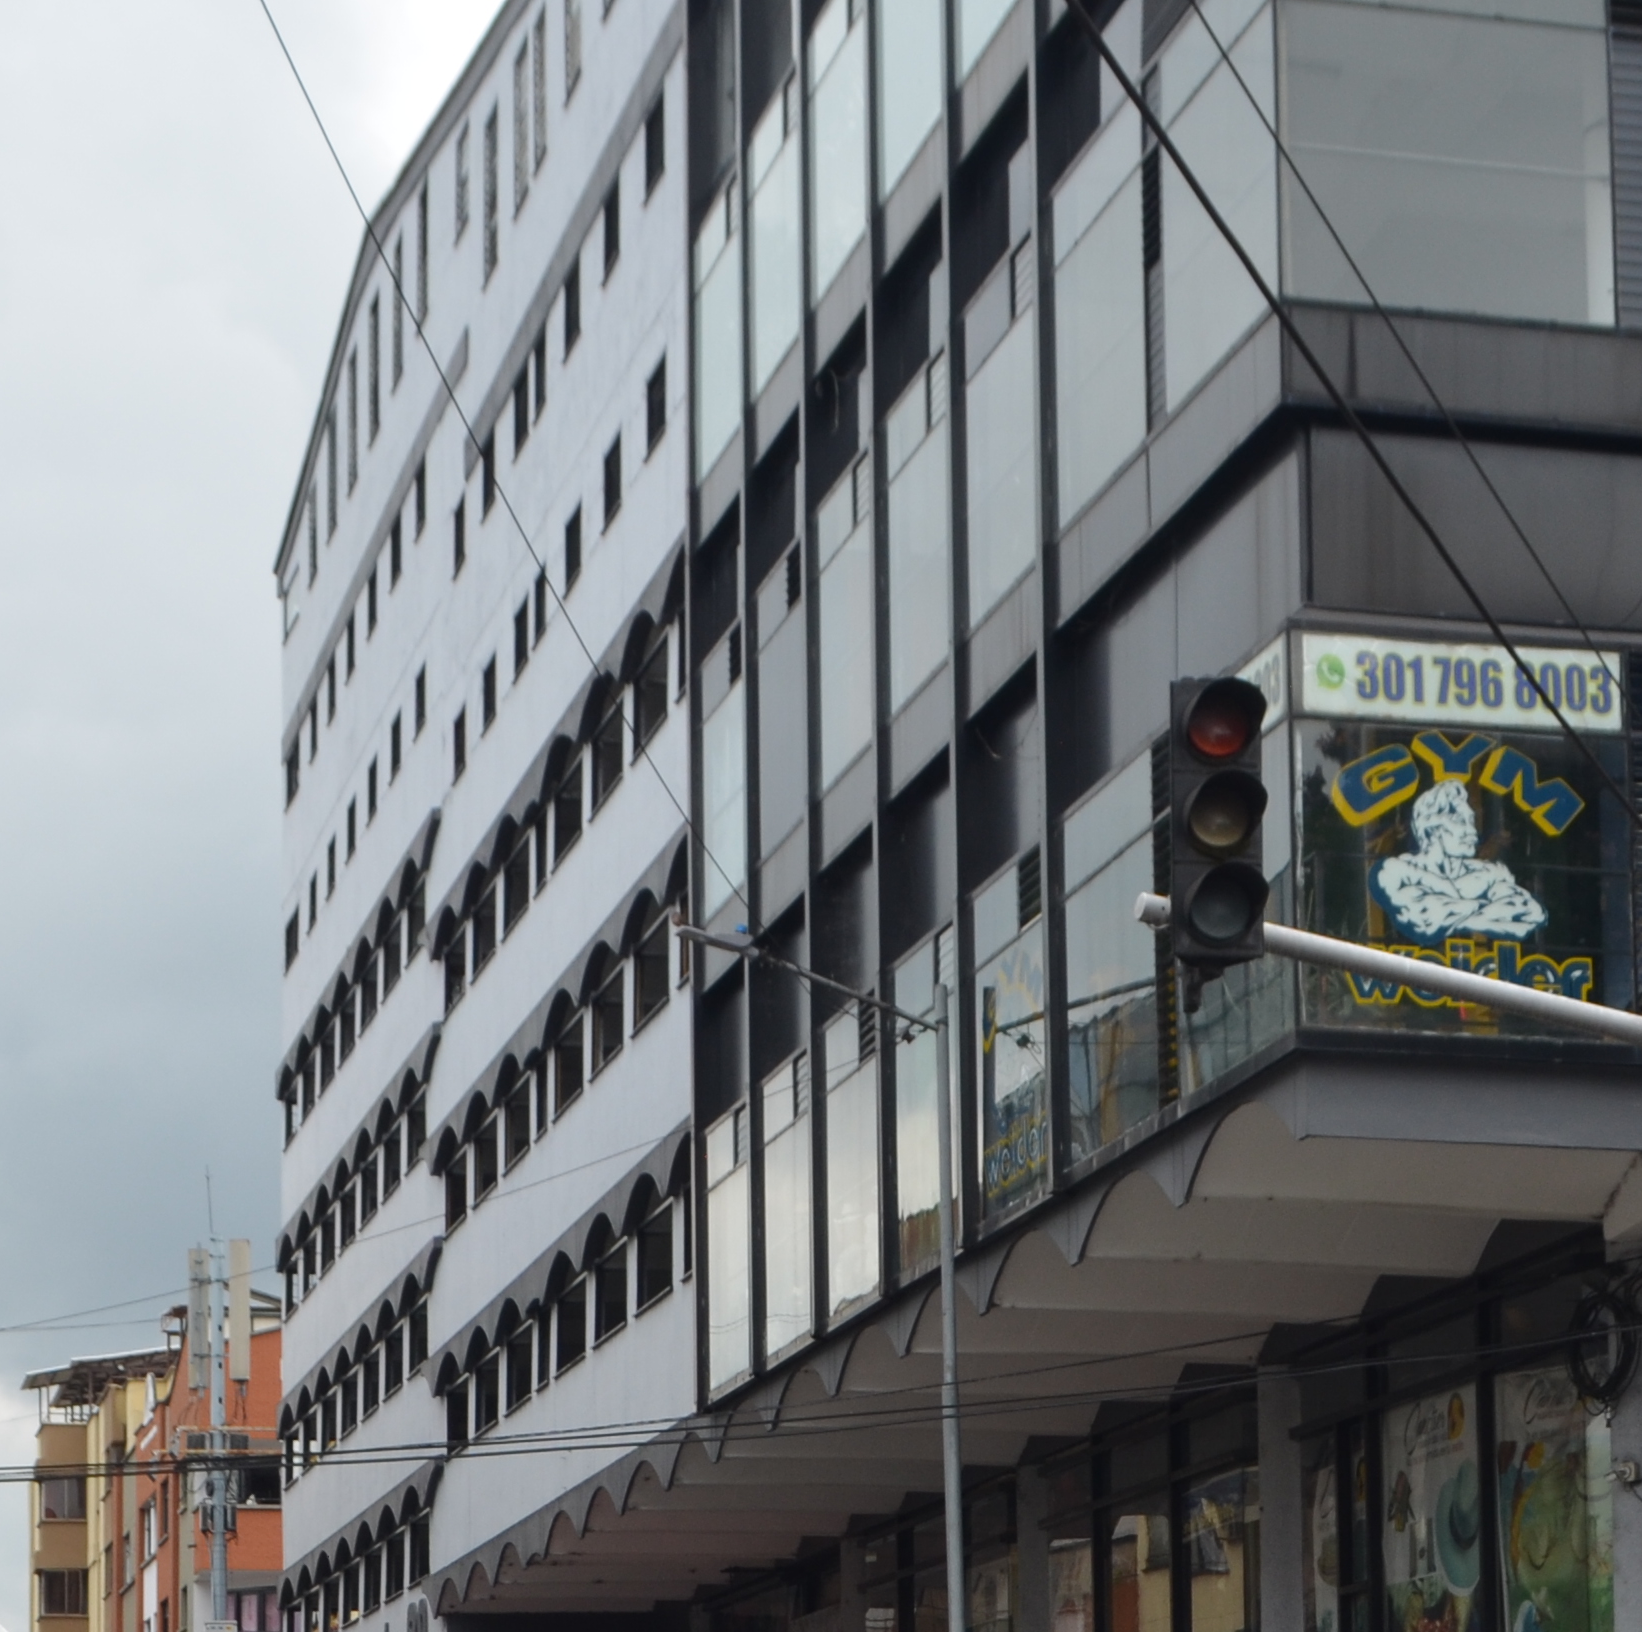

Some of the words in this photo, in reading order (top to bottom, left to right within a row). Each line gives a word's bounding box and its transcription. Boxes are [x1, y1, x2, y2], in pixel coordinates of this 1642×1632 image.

[1354, 650, 1424, 703] 301
[1433, 655, 1504, 708] 796
[1513, 661, 1614, 714] 8003
[1330, 730, 1586, 838] GYM
